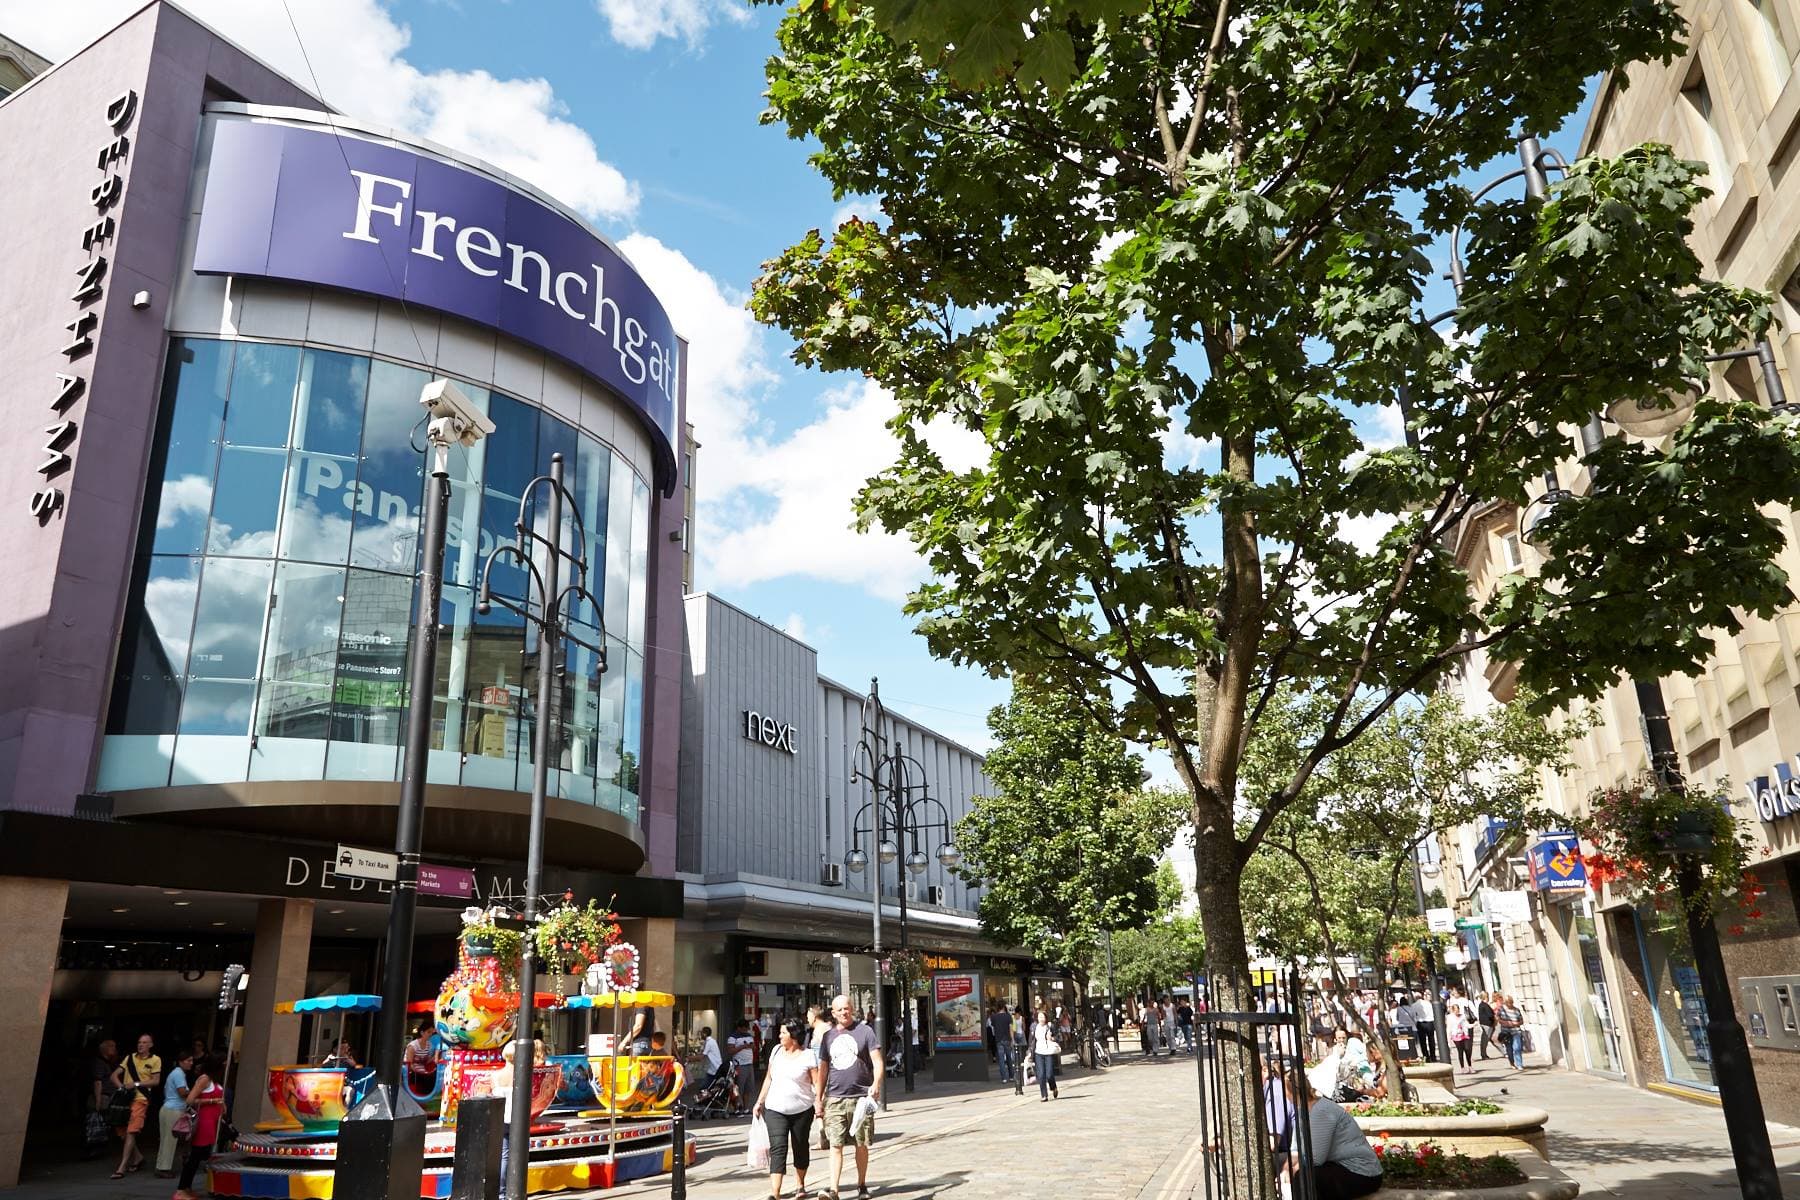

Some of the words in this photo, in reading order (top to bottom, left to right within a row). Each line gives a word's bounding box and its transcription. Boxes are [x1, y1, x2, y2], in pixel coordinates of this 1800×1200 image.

[30, 89, 137, 520] DEBENHAMS
[343, 169, 678, 402] Frenchgat
[346, 662, 379, 673] Panasonic
[379, 666, 401, 675] Store?
[746, 710, 798, 753] next
[1745, 755, 1800, 823] Yorks
[377, 861, 389, 869] Rank
[421, 880, 440, 889] Markets
